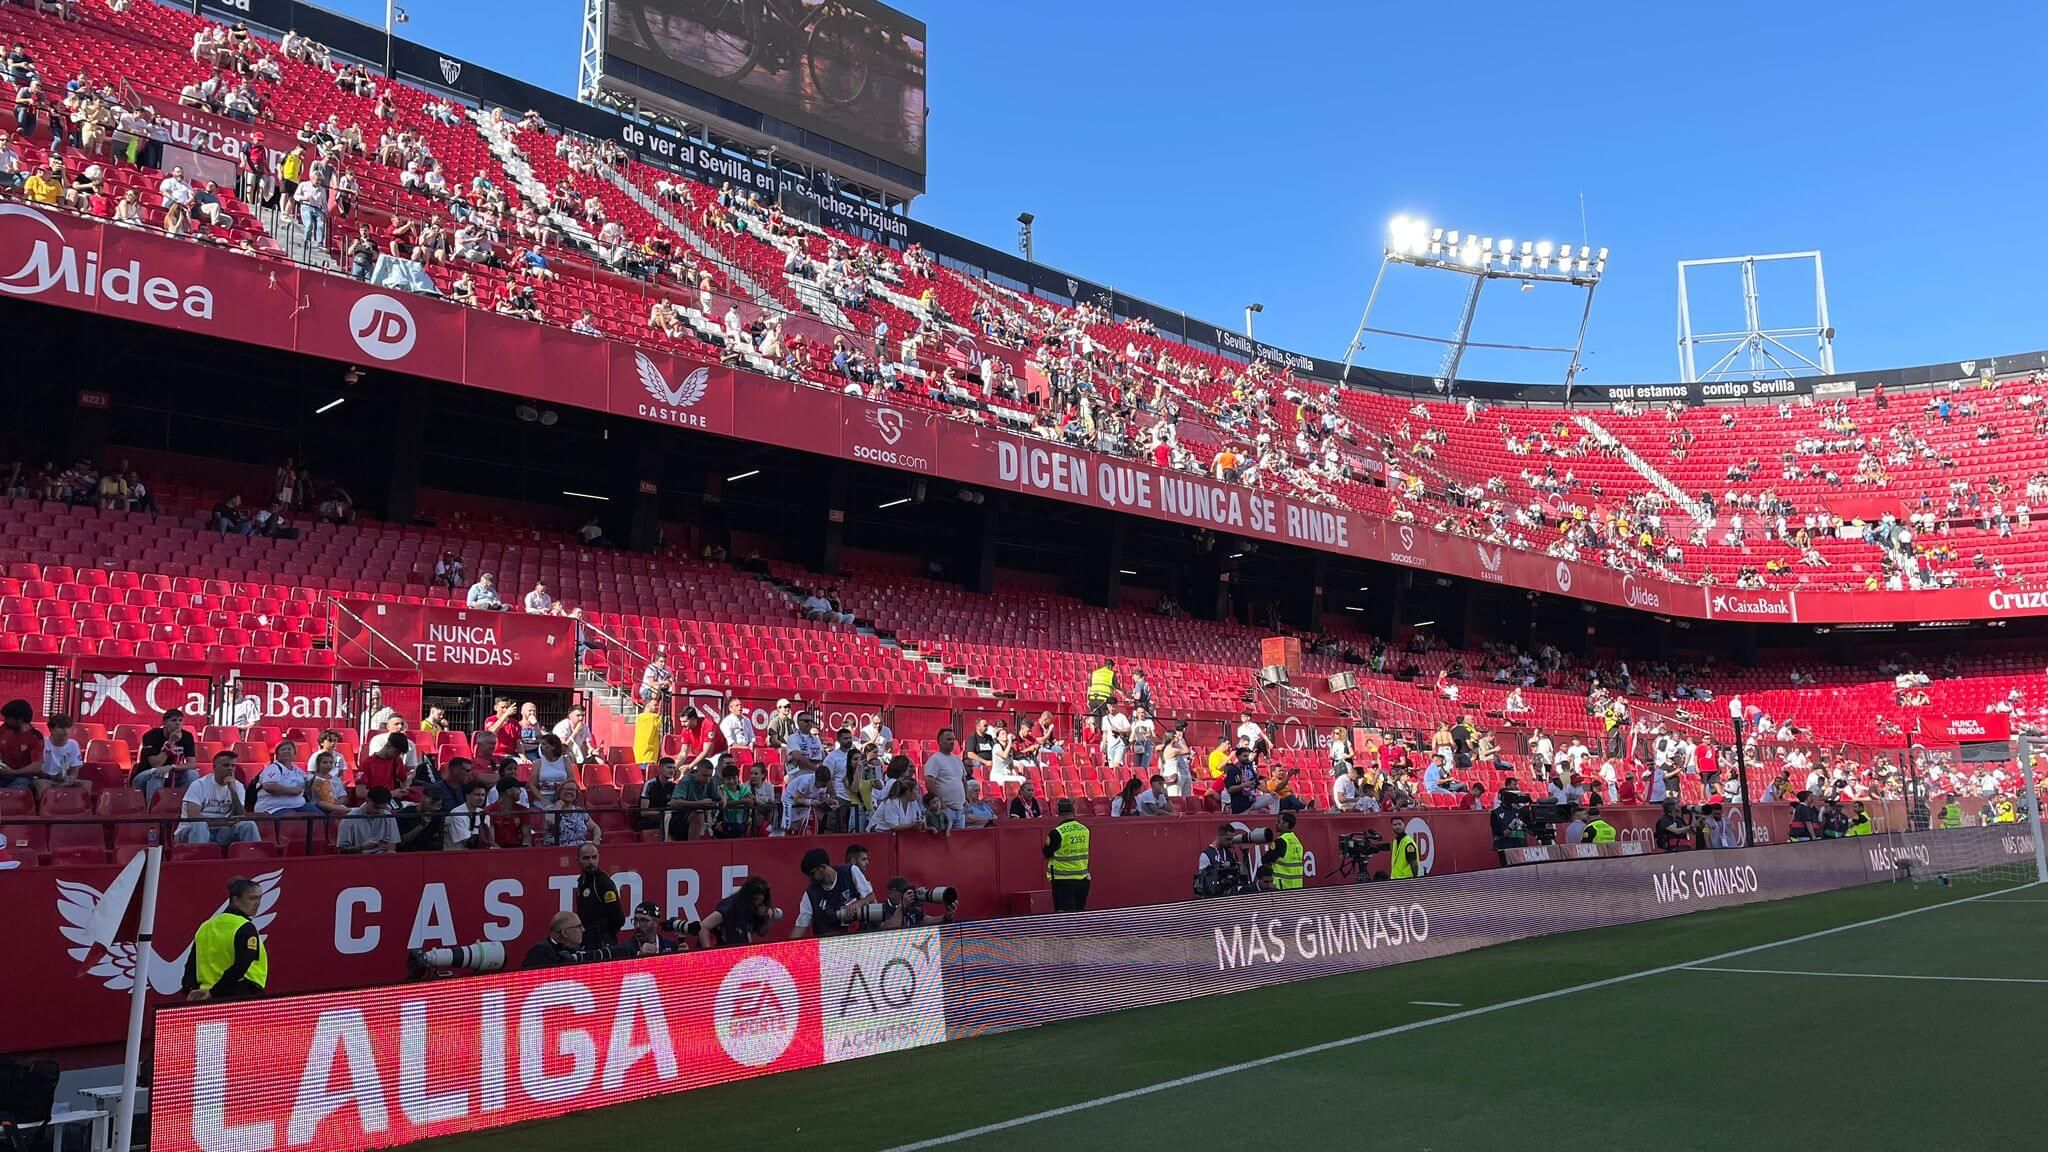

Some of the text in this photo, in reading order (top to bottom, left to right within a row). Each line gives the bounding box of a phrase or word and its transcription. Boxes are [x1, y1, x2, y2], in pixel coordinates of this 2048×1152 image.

[623, 124, 644, 146] de
[649, 135, 676, 157] ver
[681, 146, 694, 164] al
[699, 150, 751, 184] Sevilla
[756, 173, 774, 191] en
[0, 215, 213, 320] Midea
[359, 309, 407, 344] JD
[1216, 329, 1222, 343] Y
[1609, 379, 1795, 400] aquí estamos contigo Sevilla
[638, 403, 707, 428] CASTORE
[998, 440, 1349, 548] DICEN QUE NUNCA SE RINDE
[1624, 579, 1659, 607] Midea
[1729, 596, 1789, 615] CaixaBank
[429, 623, 497, 646] NUNCA
[413, 643, 513, 667] TE RINDAS
[1653, 864, 1758, 904] MÁS GIMNASIO
[1214, 903, 1429, 970] MÁS GIMNASIO
[732, 979, 784, 1018] EA
[192, 972, 679, 1152] LALIGA
